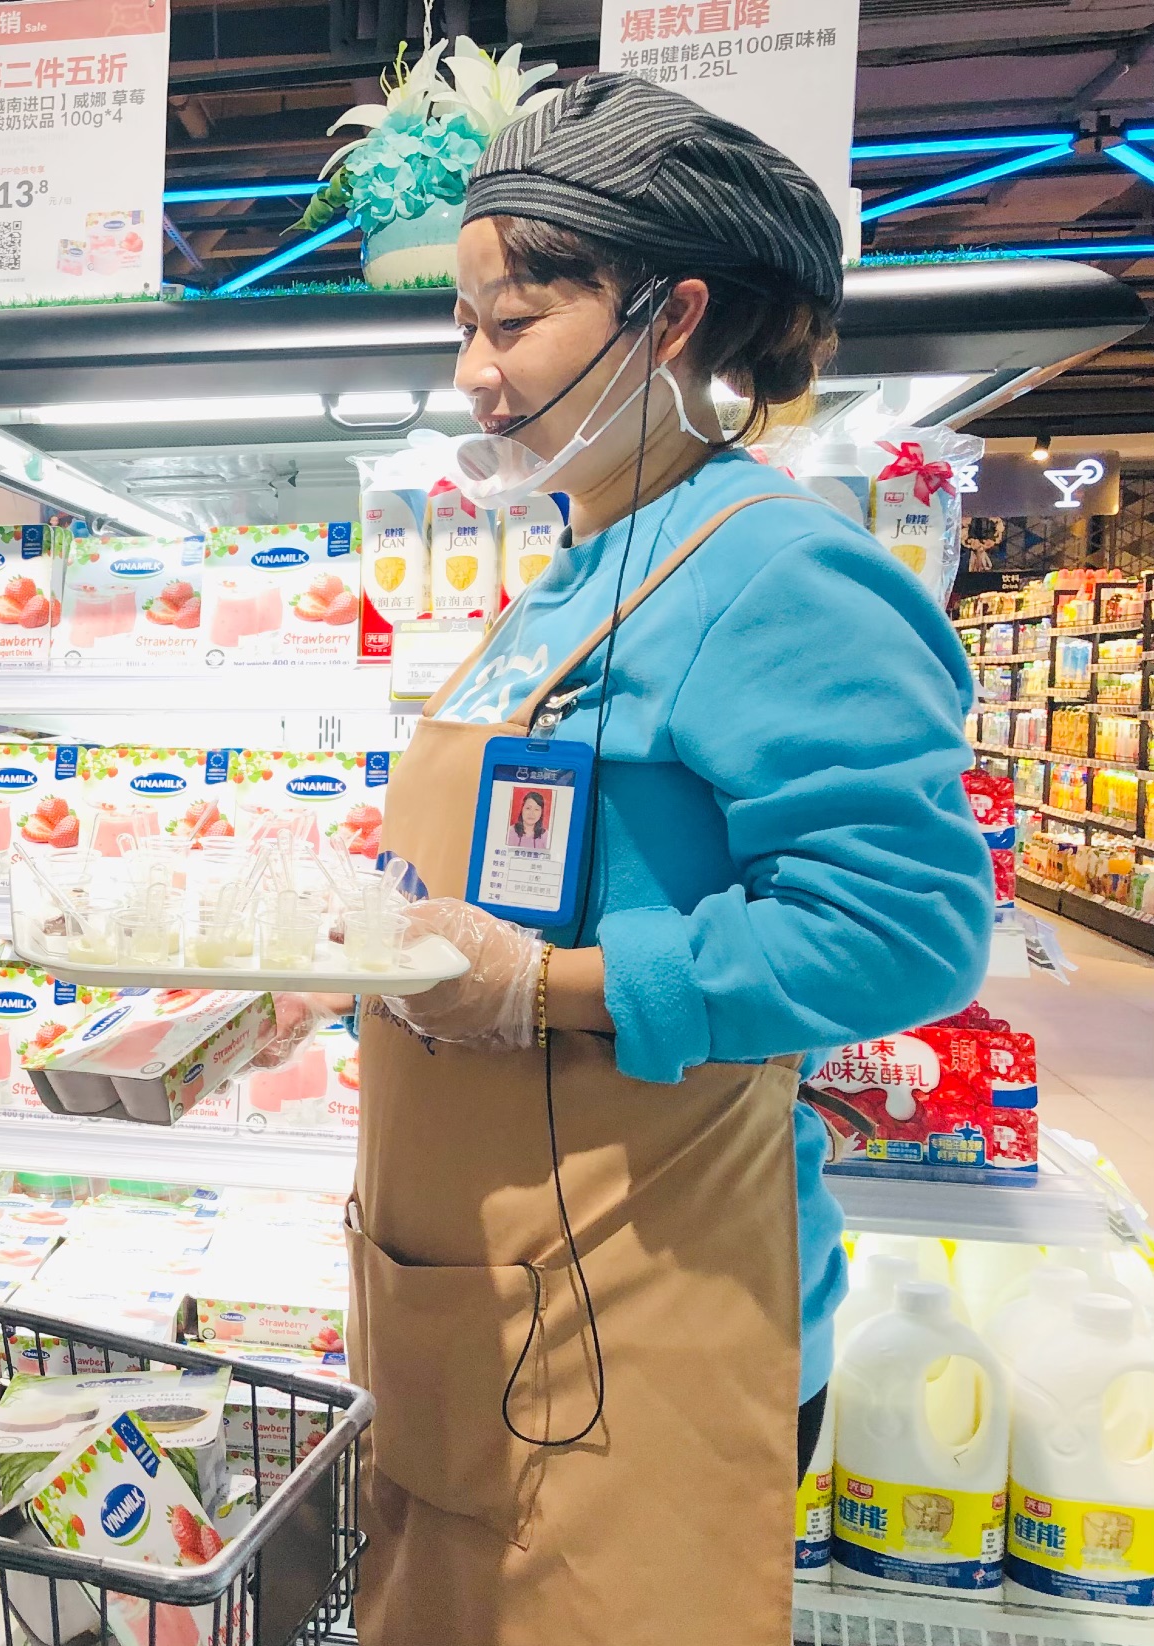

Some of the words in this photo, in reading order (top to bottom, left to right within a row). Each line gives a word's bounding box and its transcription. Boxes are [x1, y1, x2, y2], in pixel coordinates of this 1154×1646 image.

[25, 22, 47, 34] Sale
[620, 0, 770, 43] 爆款直降
[620, 28, 836, 69] 光明健能AB100原味桶
[112, 88, 146, 106] 草莓
[254, 552, 307, 565] VINAMILK
[113, 562, 162, 573] VINAMILK
[136, 636, 198, 648] Strawberry
[283, 632, 350, 646] Strawberry
[16, 649, 33, 657] Drink
[296, 647, 318, 656] Yogurt
[319, 646, 338, 654] Drink
[133, 779, 184, 790] VINAMILK
[290, 781, 344, 792] VINAMILK
[213, 1029, 250, 1063] Strawberry
[842, 1039, 896, 1062] 红枣
[200, 1109, 219, 1117] Drink
[259, 1317, 309, 1331] Strawberry
[82, 1379, 147, 1388] VINAMILK
[848, 1480, 872, 1495] 光明
[104, 1490, 144, 1532] VINAMILK
[838, 1495, 888, 1531] 健能
[1015, 1513, 1067, 1550] 健能
